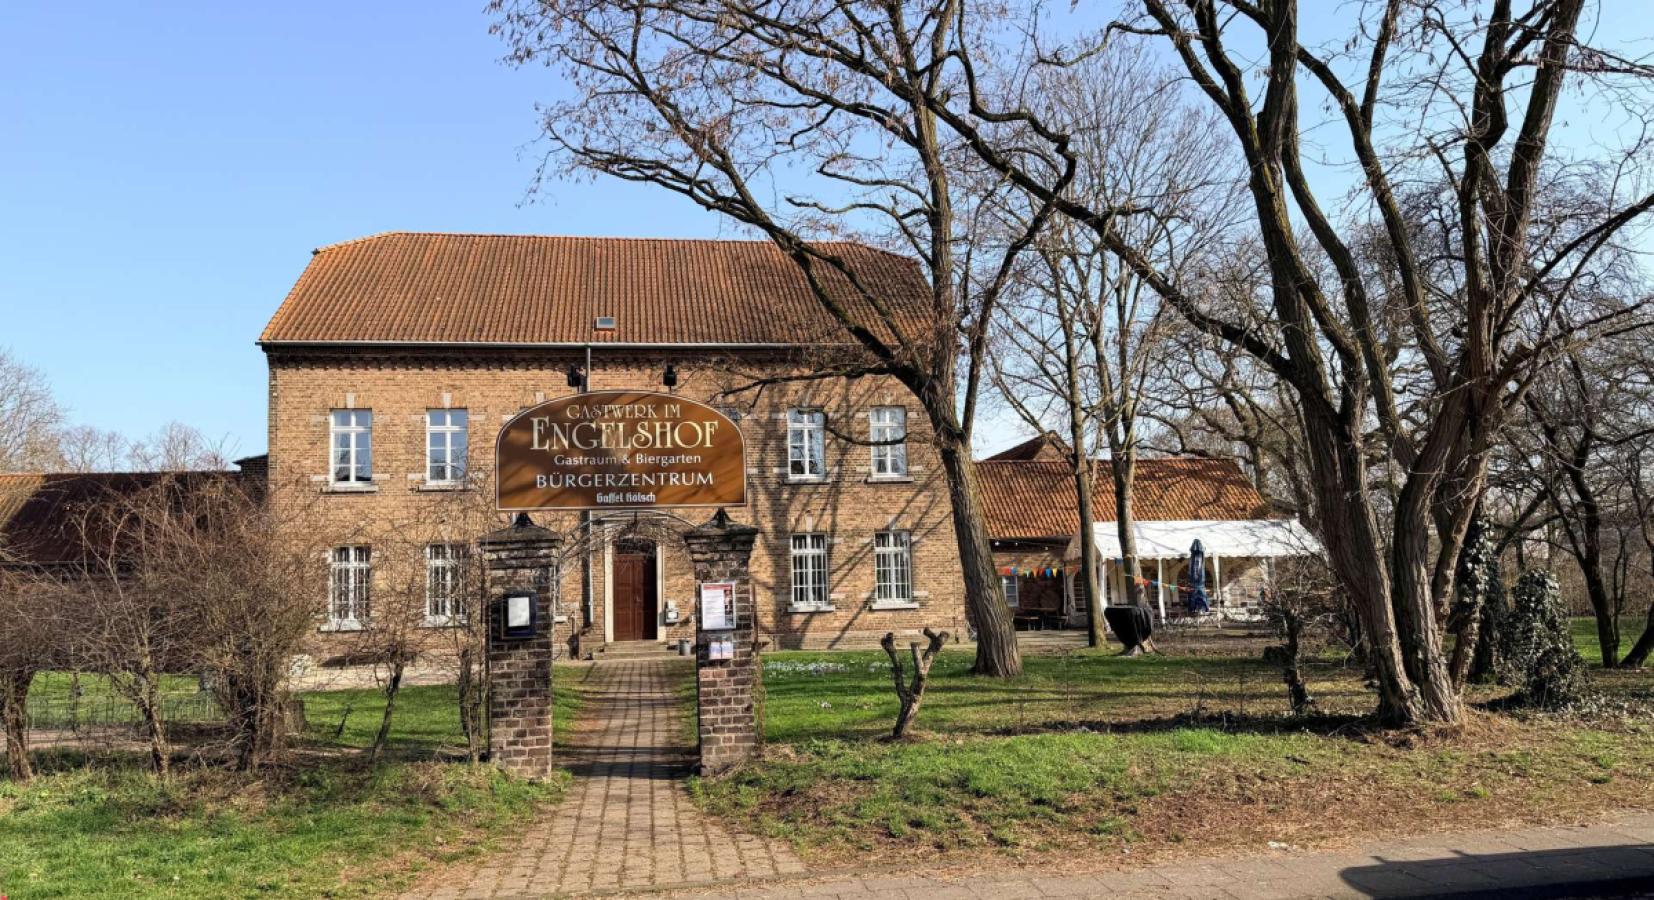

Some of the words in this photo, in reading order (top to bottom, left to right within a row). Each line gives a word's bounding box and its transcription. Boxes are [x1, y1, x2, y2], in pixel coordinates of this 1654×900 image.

[566, 404, 657, 420] GASTWERK
[664, 404, 681, 418] IM
[530, 416, 719, 451] ENGELSHOF
[554, 454, 617, 466] Gastraum
[622, 454, 630, 465] &
[636, 453, 701, 467] Biergarten
[536, 472, 714, 489] BÜRGERZENTRUM
